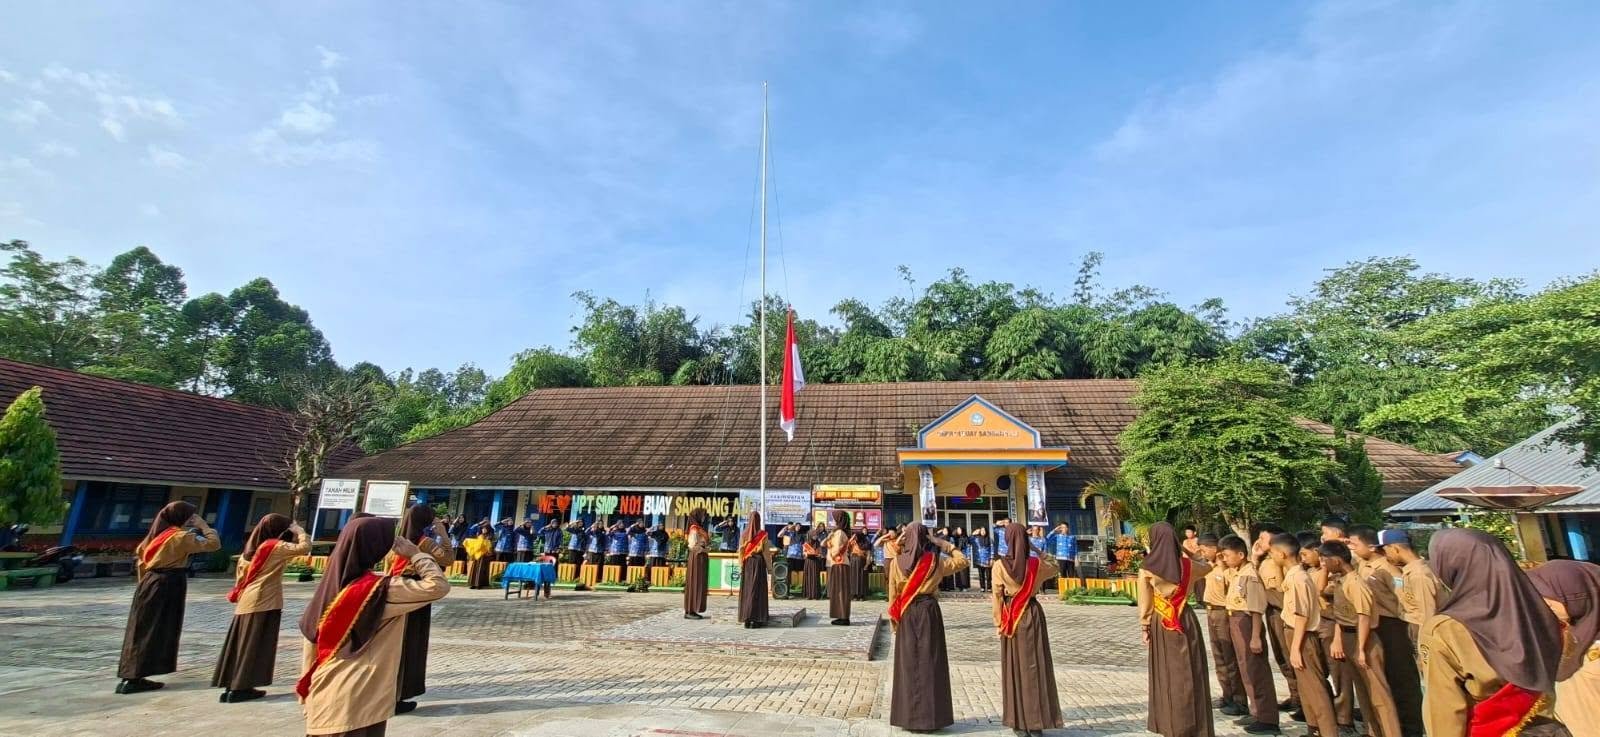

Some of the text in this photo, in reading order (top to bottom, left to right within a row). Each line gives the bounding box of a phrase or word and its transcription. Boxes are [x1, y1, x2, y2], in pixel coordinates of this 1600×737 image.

[538, 494, 554, 514] WE
[595, 494, 618, 515] SMP
[643, 495, 673, 516] BUAY
